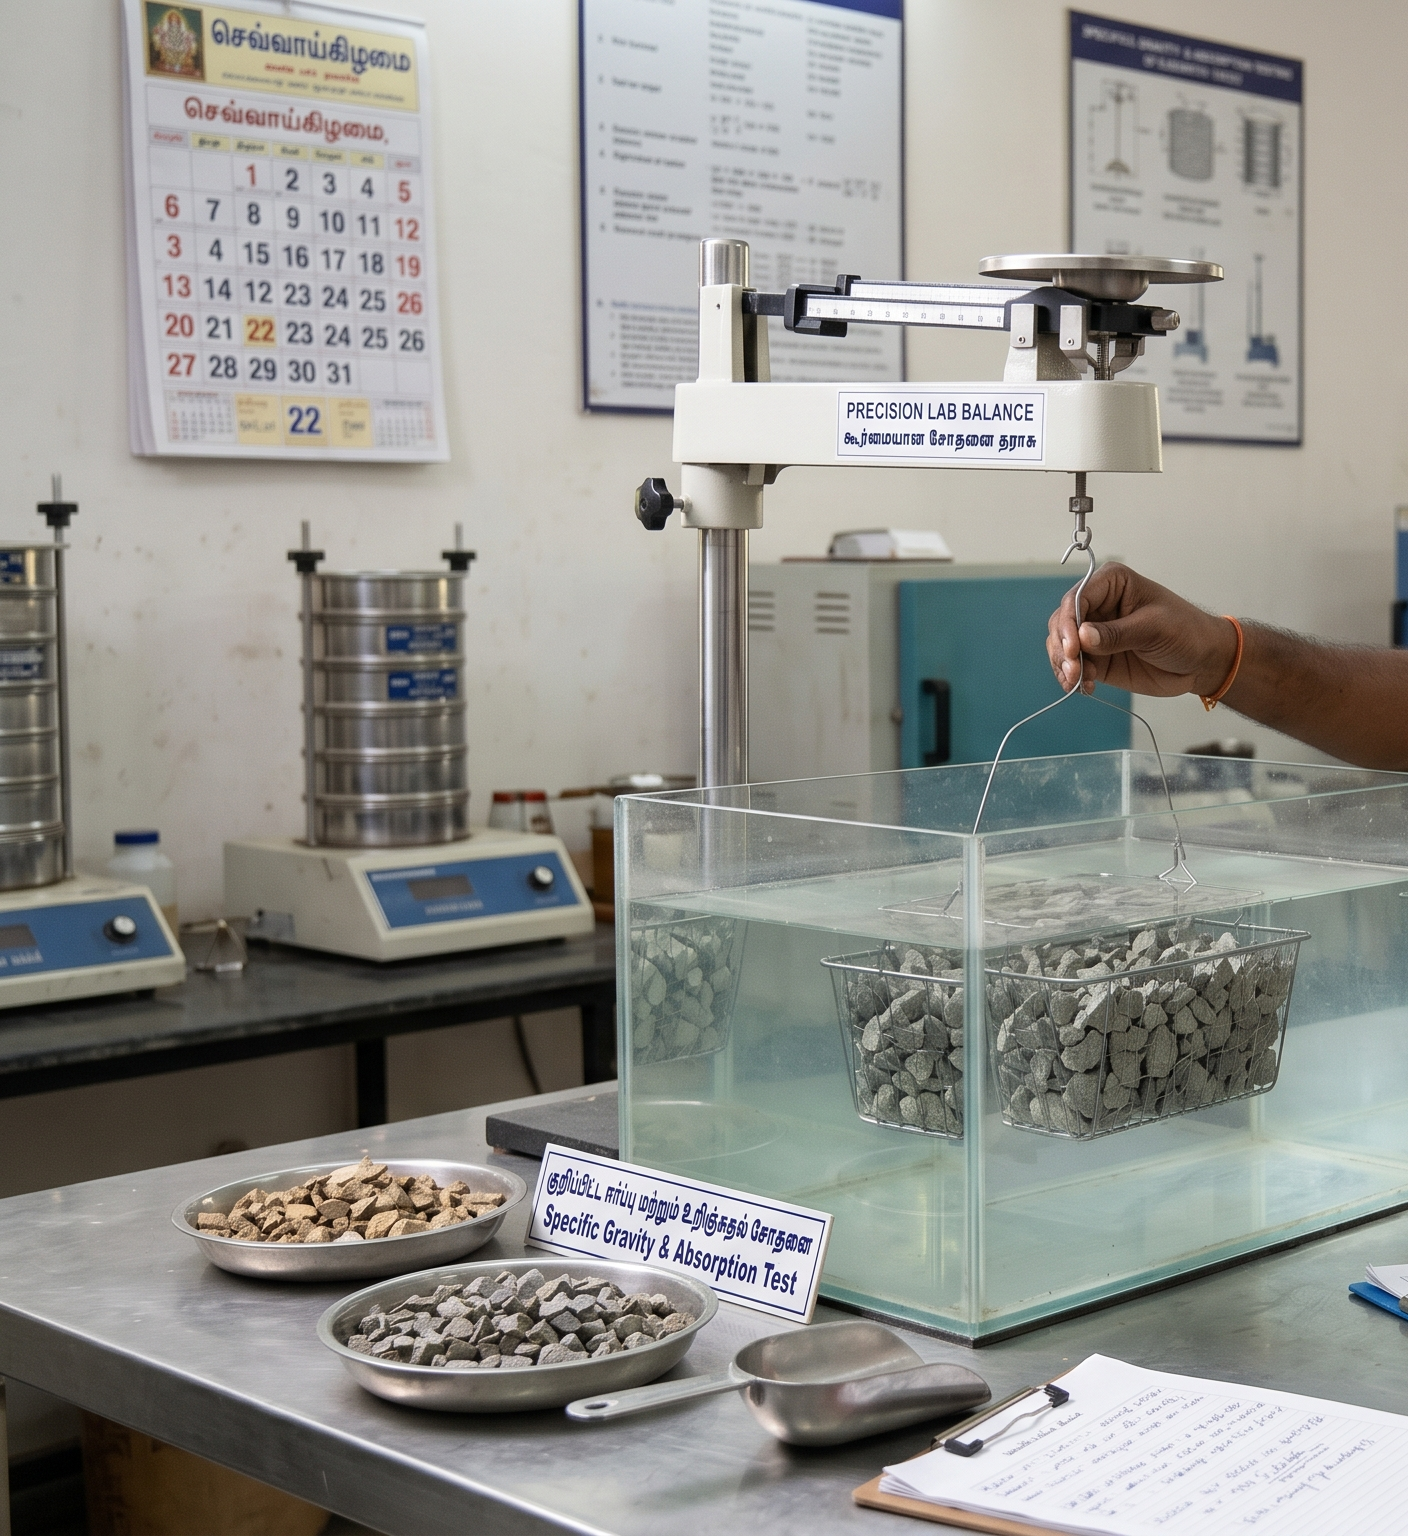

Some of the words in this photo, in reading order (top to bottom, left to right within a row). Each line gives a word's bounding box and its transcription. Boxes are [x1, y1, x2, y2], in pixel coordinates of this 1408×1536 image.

[246, 163, 257, 186] 1
[285, 168, 299, 191] 2
[323, 172, 337, 195] 3
[361, 178, 374, 198] 4
[398, 181, 411, 203] 5
[165, 194, 179, 218] 6
[206, 199, 220, 221] 7
[248, 203, 261, 225] 8
[286, 206, 299, 229] 9
[320, 210, 345, 234] 10
[357, 215, 379, 237] 11
[395, 217, 419, 241] 12
[166, 234, 182, 258] 3
[209, 238, 223, 260] 4
[245, 242, 269, 265] 15
[284, 245, 308, 269] 16
[321, 248, 346, 271] 17
[359, 253, 384, 275] 18
[397, 255, 421, 278] 19
[163, 275, 191, 298] 13
[204, 277, 232, 300] 14
[246, 281, 272, 304] 12
[284, 284, 311, 306] 23
[322, 286, 348, 309] 24
[360, 290, 386, 312] 25
[397, 292, 422, 315] 26
[165, 314, 194, 337] 20
[207, 316, 232, 339] 21
[247, 319, 275, 343] 22
[286, 321, 313, 344] 23
[325, 324, 351, 347] 24
[362, 327, 388, 350] 25
[399, 330, 425, 352] 26
[167, 353, 196, 377] 27
[209, 356, 237, 379] 28
[250, 358, 276, 381] 29
[288, 360, 315, 383] 30
[327, 363, 351, 384] 31
[288, 406, 322, 434] 22
[846, 402, 923, 420] PRECISION
[927, 403, 957, 420] LAB
[961, 403, 1034, 421] BALANCE
[929, 429, 994, 452] சோதனை
[998, 434, 1037, 453] தராசு
[638, 1190, 680, 1225] மற்றும்
[750, 1218, 813, 1255] சோதனை
[543, 1203, 600, 1236] Specific
[603, 1219, 656, 1261] Gravity
[658, 1234, 670, 1259] &
[672, 1238, 758, 1285] Absorption
[763, 1261, 798, 1296] Test
